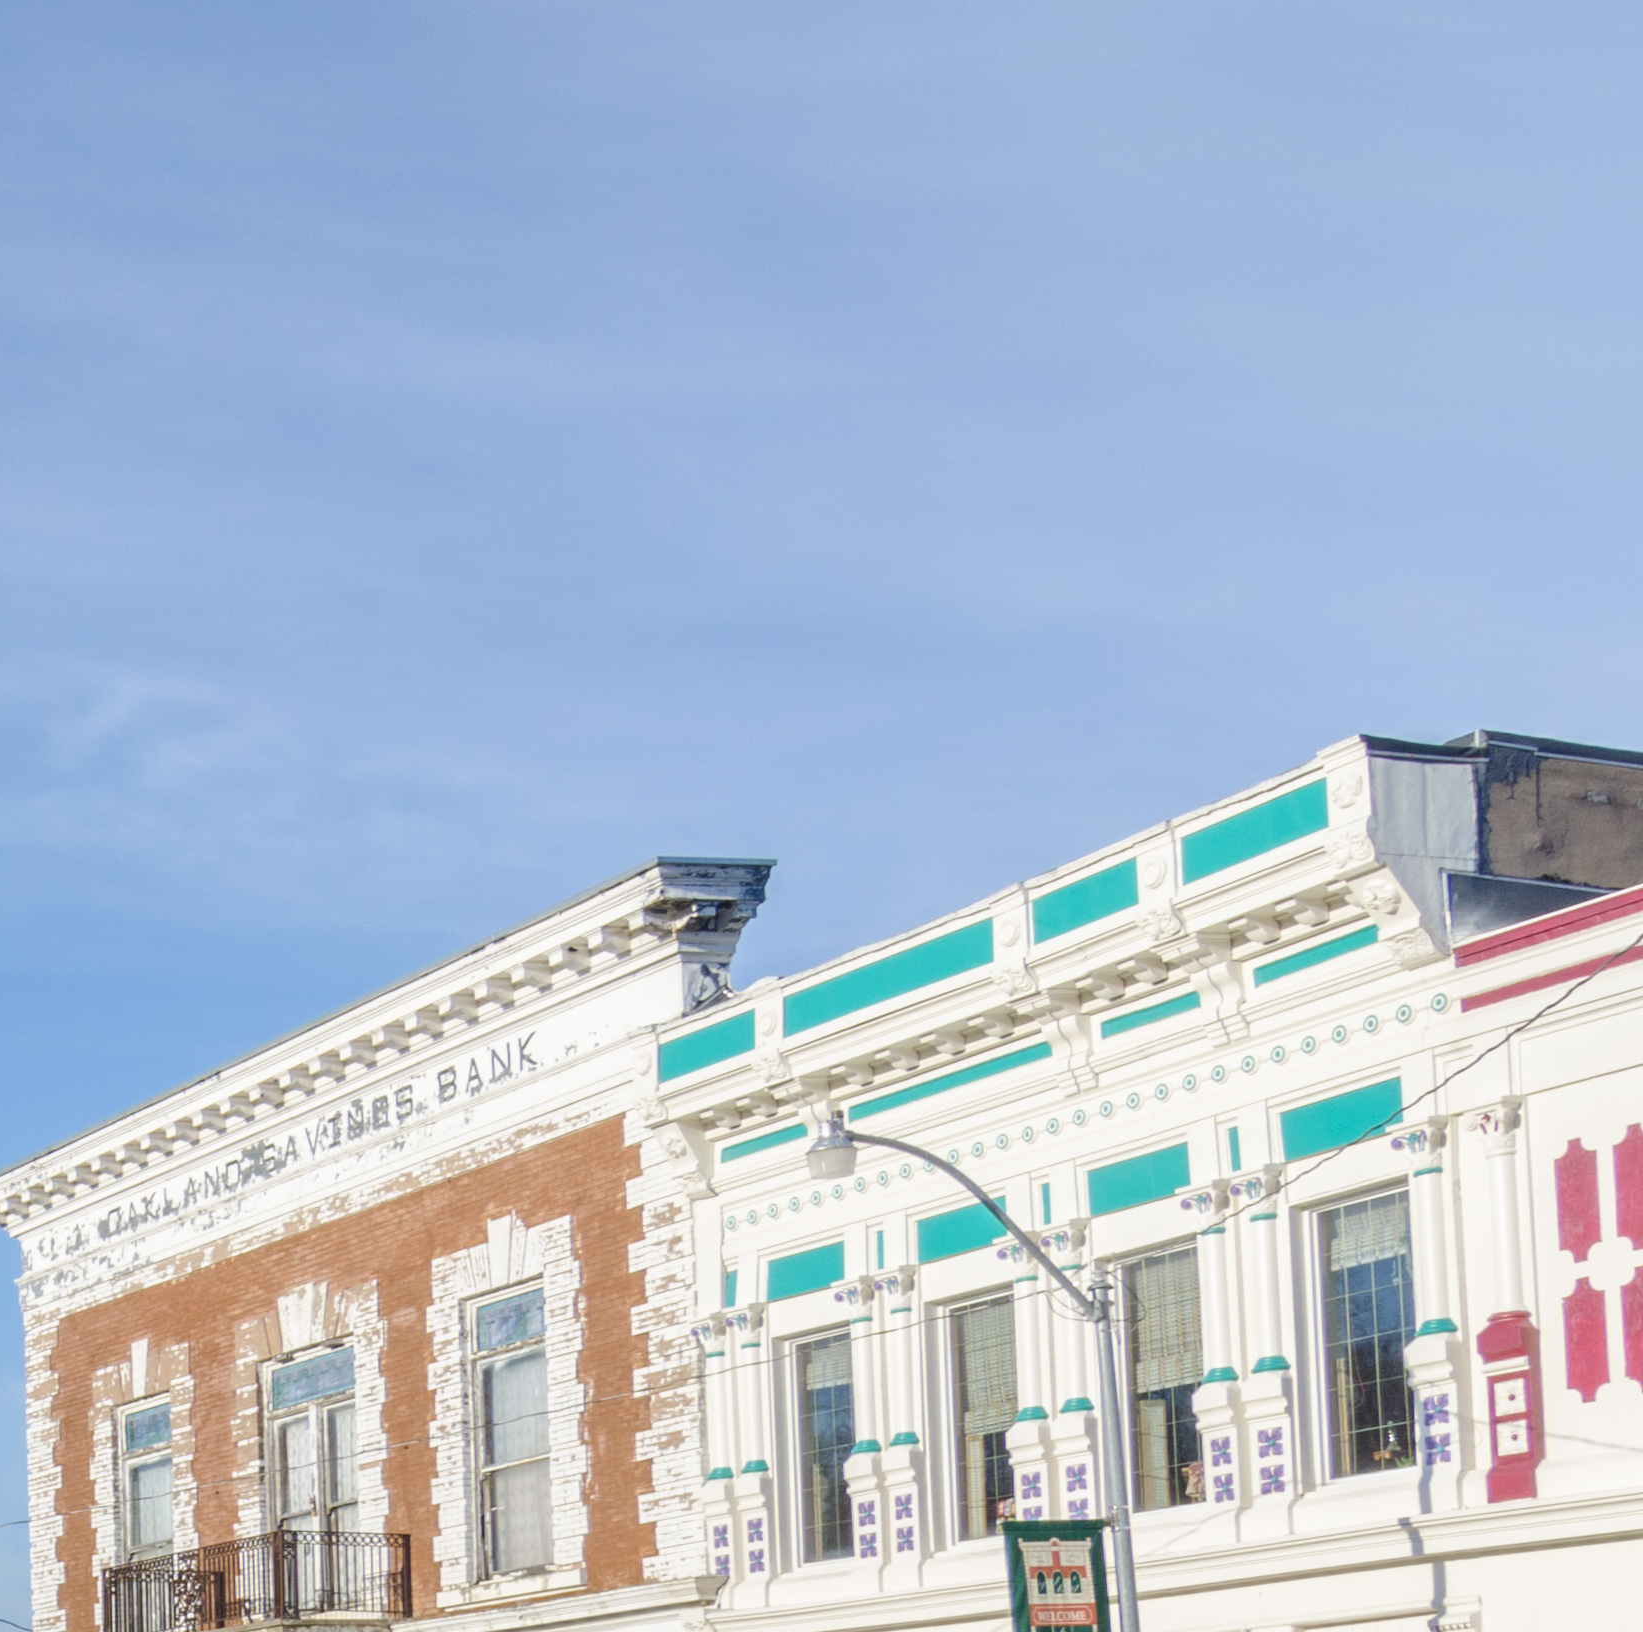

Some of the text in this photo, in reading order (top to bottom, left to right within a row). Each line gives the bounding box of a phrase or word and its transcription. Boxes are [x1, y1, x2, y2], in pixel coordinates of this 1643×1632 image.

[106, 1159, 241, 1237] OAKLAND
[437, 1030, 538, 1104] BANK
[1037, 1610, 1087, 1622] WELCOME
